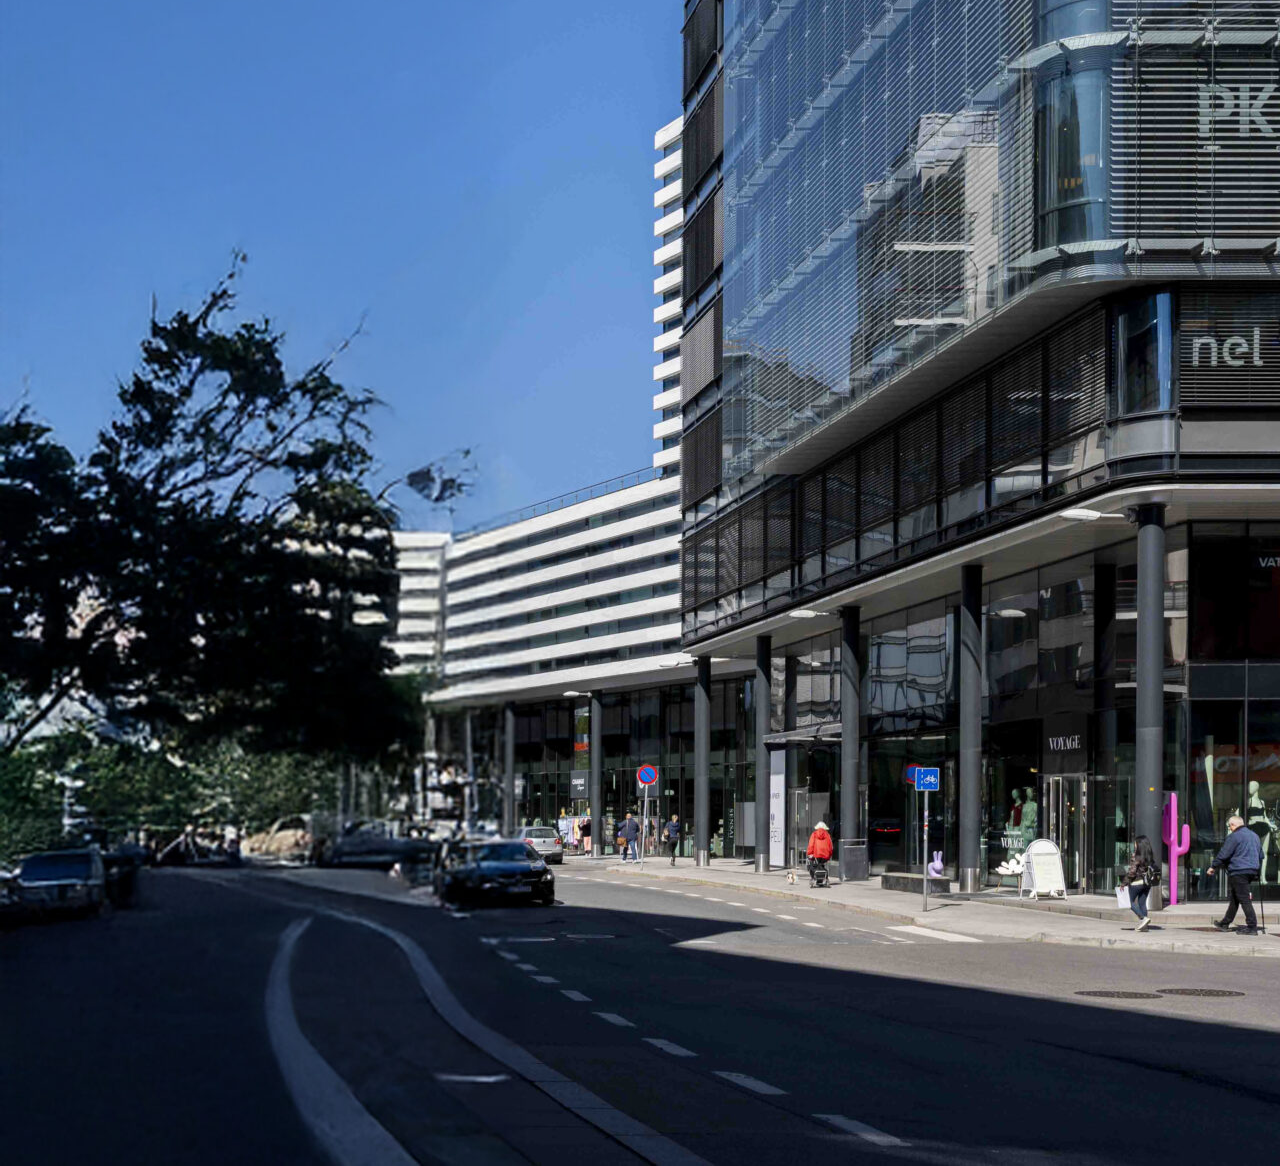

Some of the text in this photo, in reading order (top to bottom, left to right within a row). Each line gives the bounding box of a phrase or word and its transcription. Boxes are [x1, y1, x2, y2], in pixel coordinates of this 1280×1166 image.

[1192, 327, 1264, 367] nel
[1048, 734, 1081, 751] VOYAGE
[1001, 837, 1025, 849] VOYAGE
